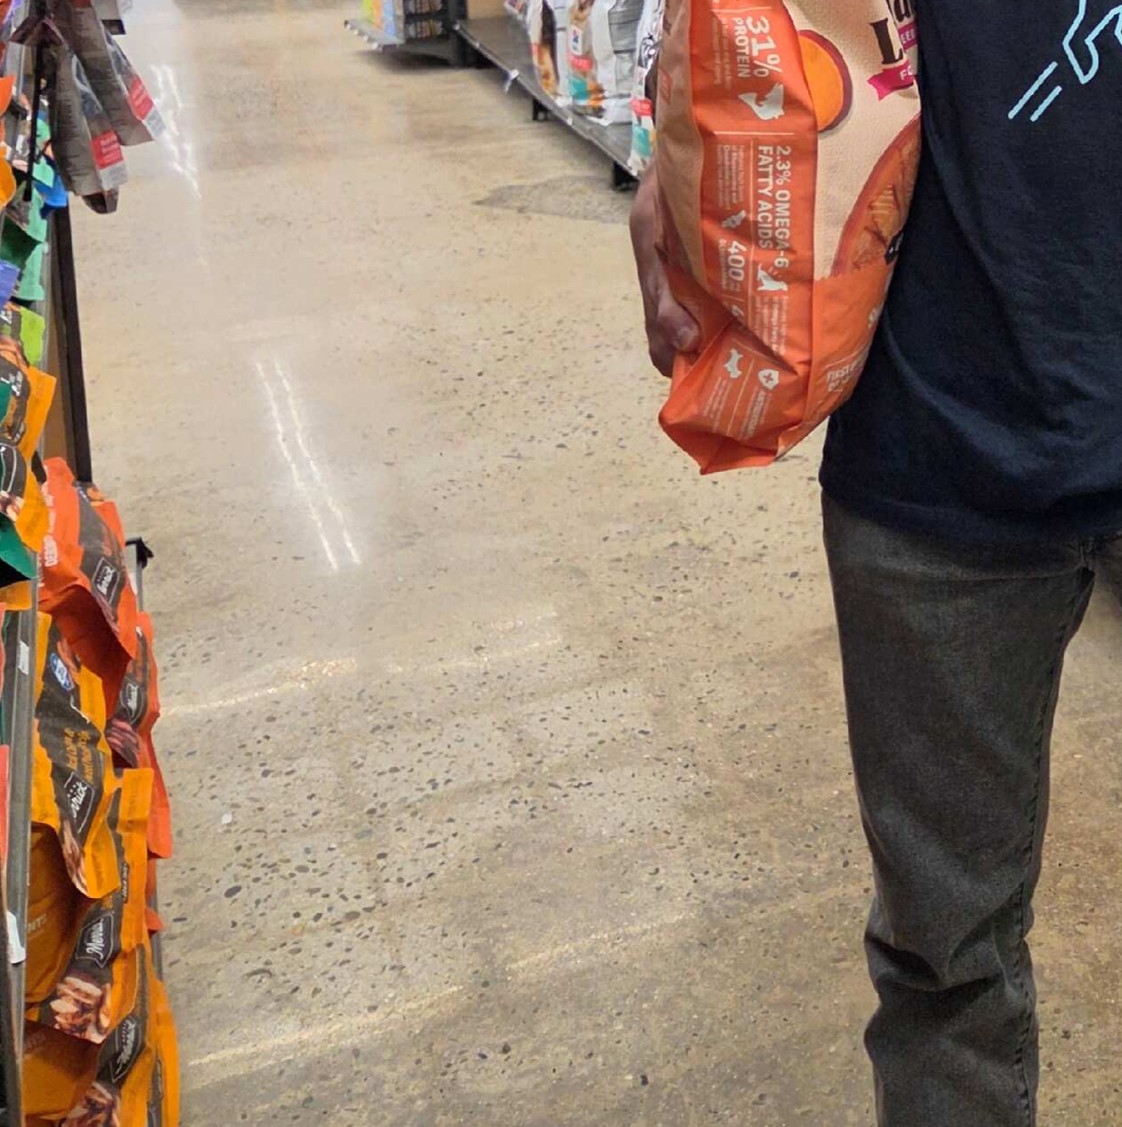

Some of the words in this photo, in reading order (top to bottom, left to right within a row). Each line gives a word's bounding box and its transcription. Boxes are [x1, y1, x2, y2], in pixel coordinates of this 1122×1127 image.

[731, 17, 751, 78] PROTEIN
[745, 15, 783, 78] 31%
[757, 145, 774, 197] FATTY
[775, 145, 793, 185] 2.3%
[757, 199, 774, 249] ACIDS
[773, 189, 792, 268] OMEGA-6
[727, 240, 747, 282] 400
